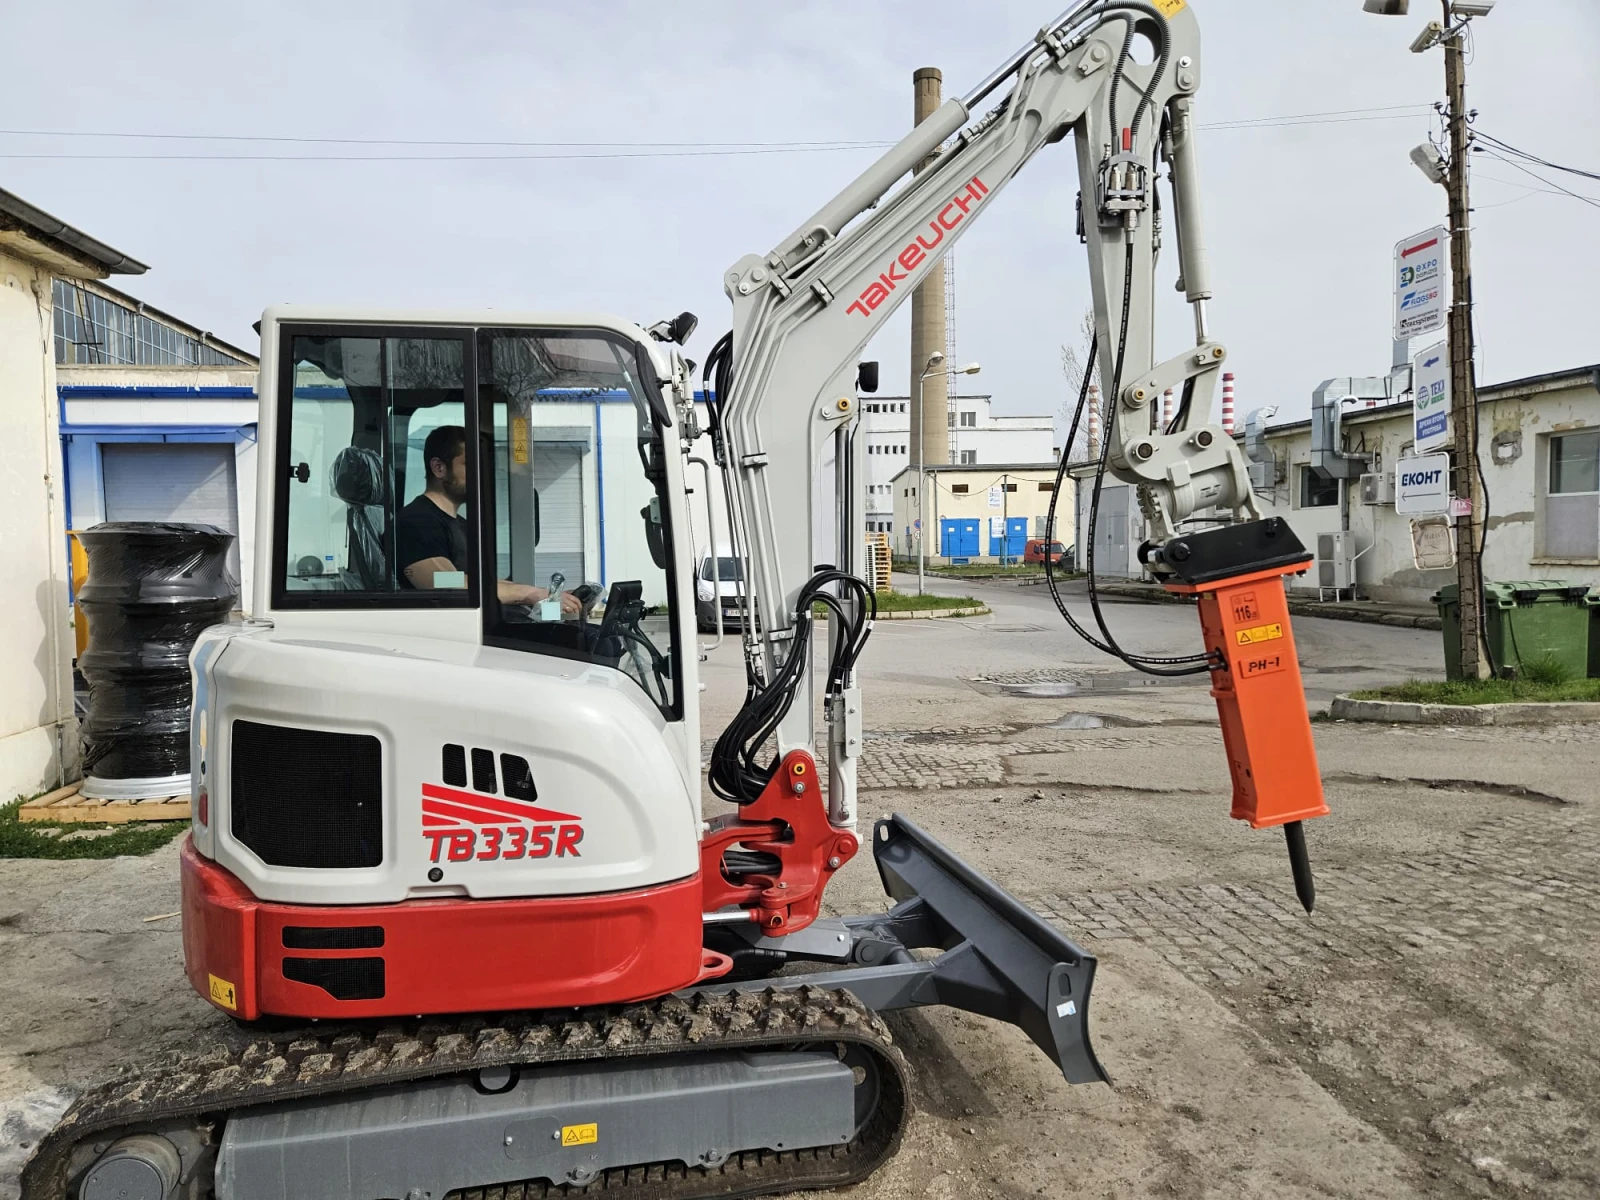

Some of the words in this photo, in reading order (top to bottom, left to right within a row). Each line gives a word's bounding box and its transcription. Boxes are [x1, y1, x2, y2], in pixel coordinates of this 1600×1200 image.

[846, 176, 989, 317] TAKEUCHI
[1401, 470, 1442, 486] ЕКОНТ
[1235, 604, 1251, 621] 116
[1248, 656, 1280, 673] PH-1
[422, 824, 584, 863] TB335R
